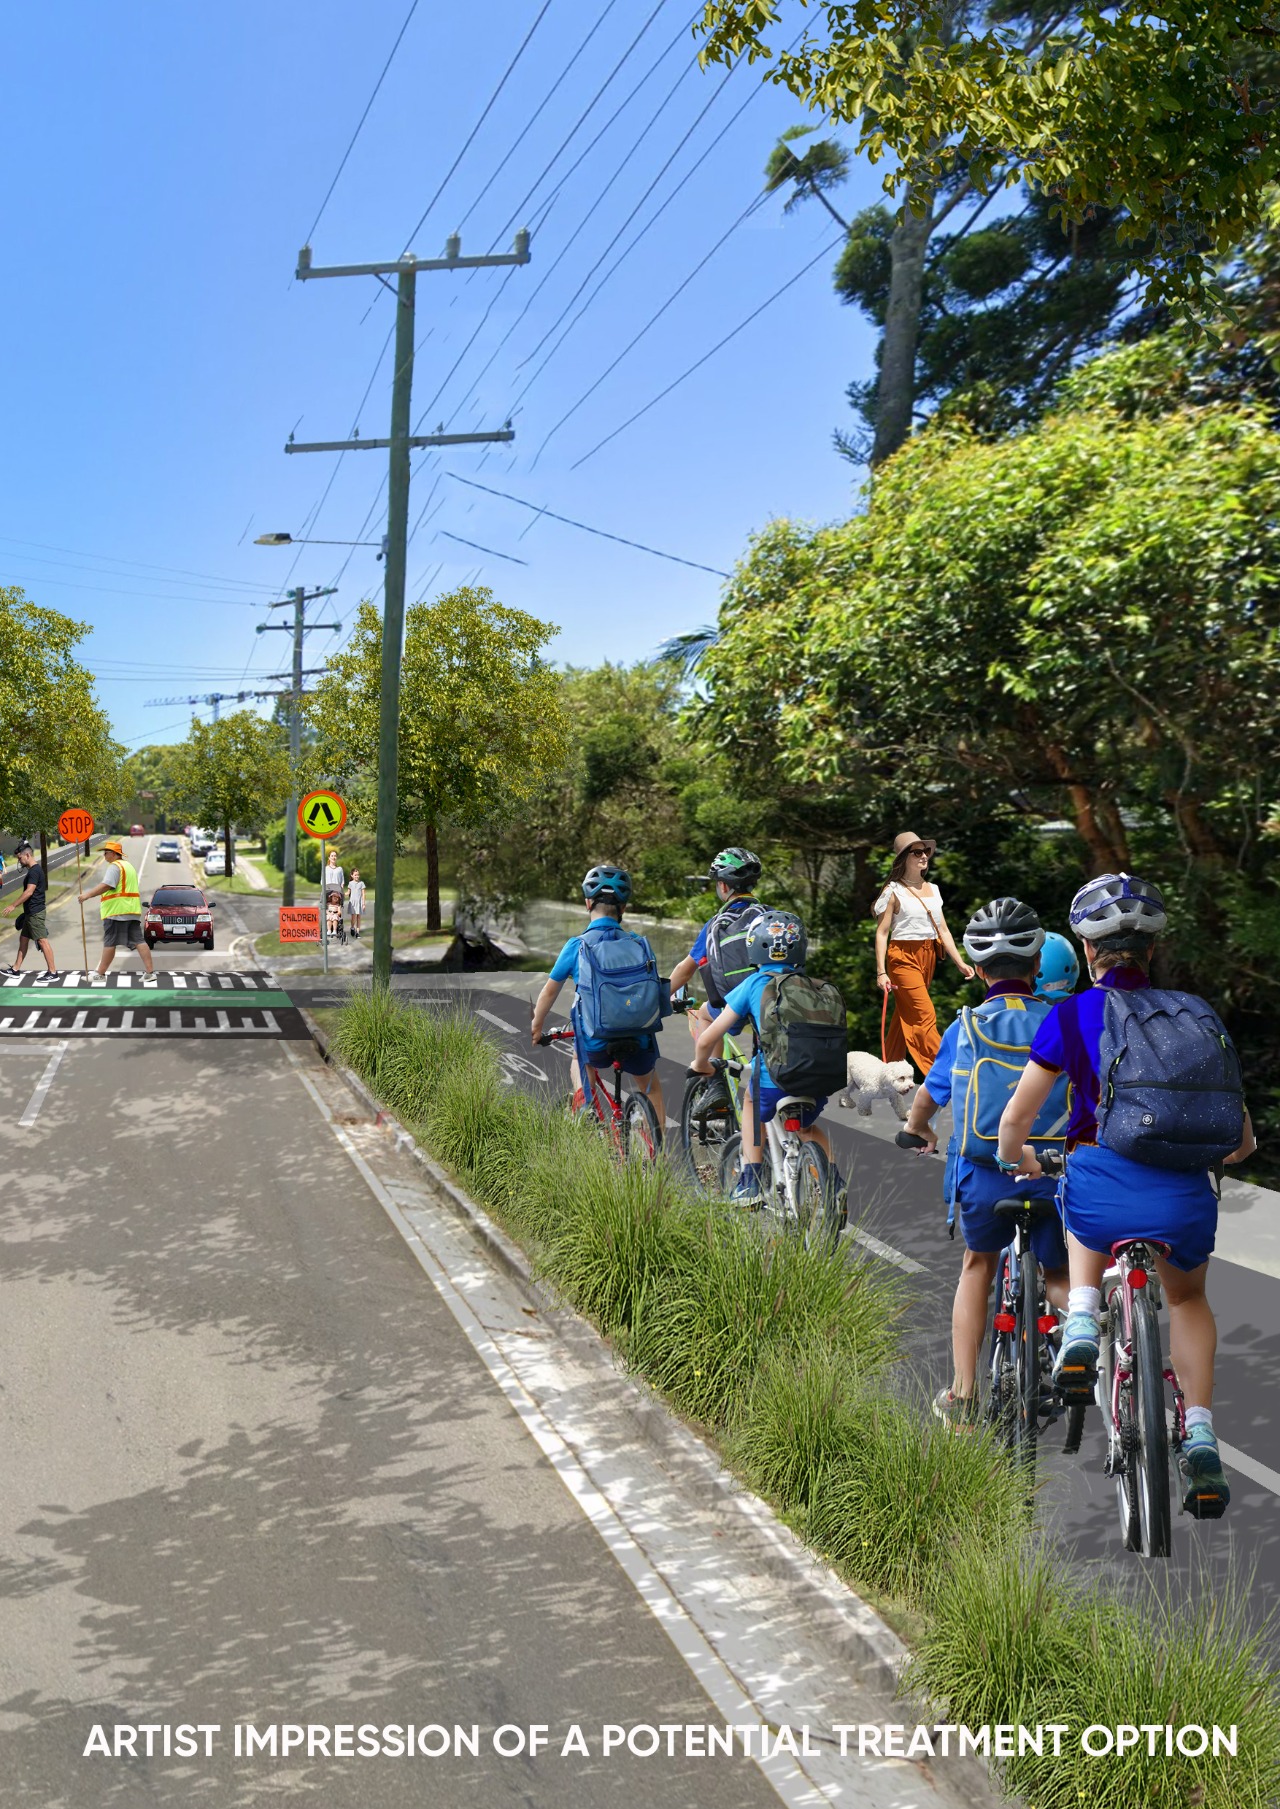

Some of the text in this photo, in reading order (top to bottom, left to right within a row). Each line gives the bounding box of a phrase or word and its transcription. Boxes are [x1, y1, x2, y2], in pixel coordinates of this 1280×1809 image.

[61, 816, 91, 835] STOP
[281, 913, 317, 922] CHILDREN
[281, 928, 318, 938] CROSSING
